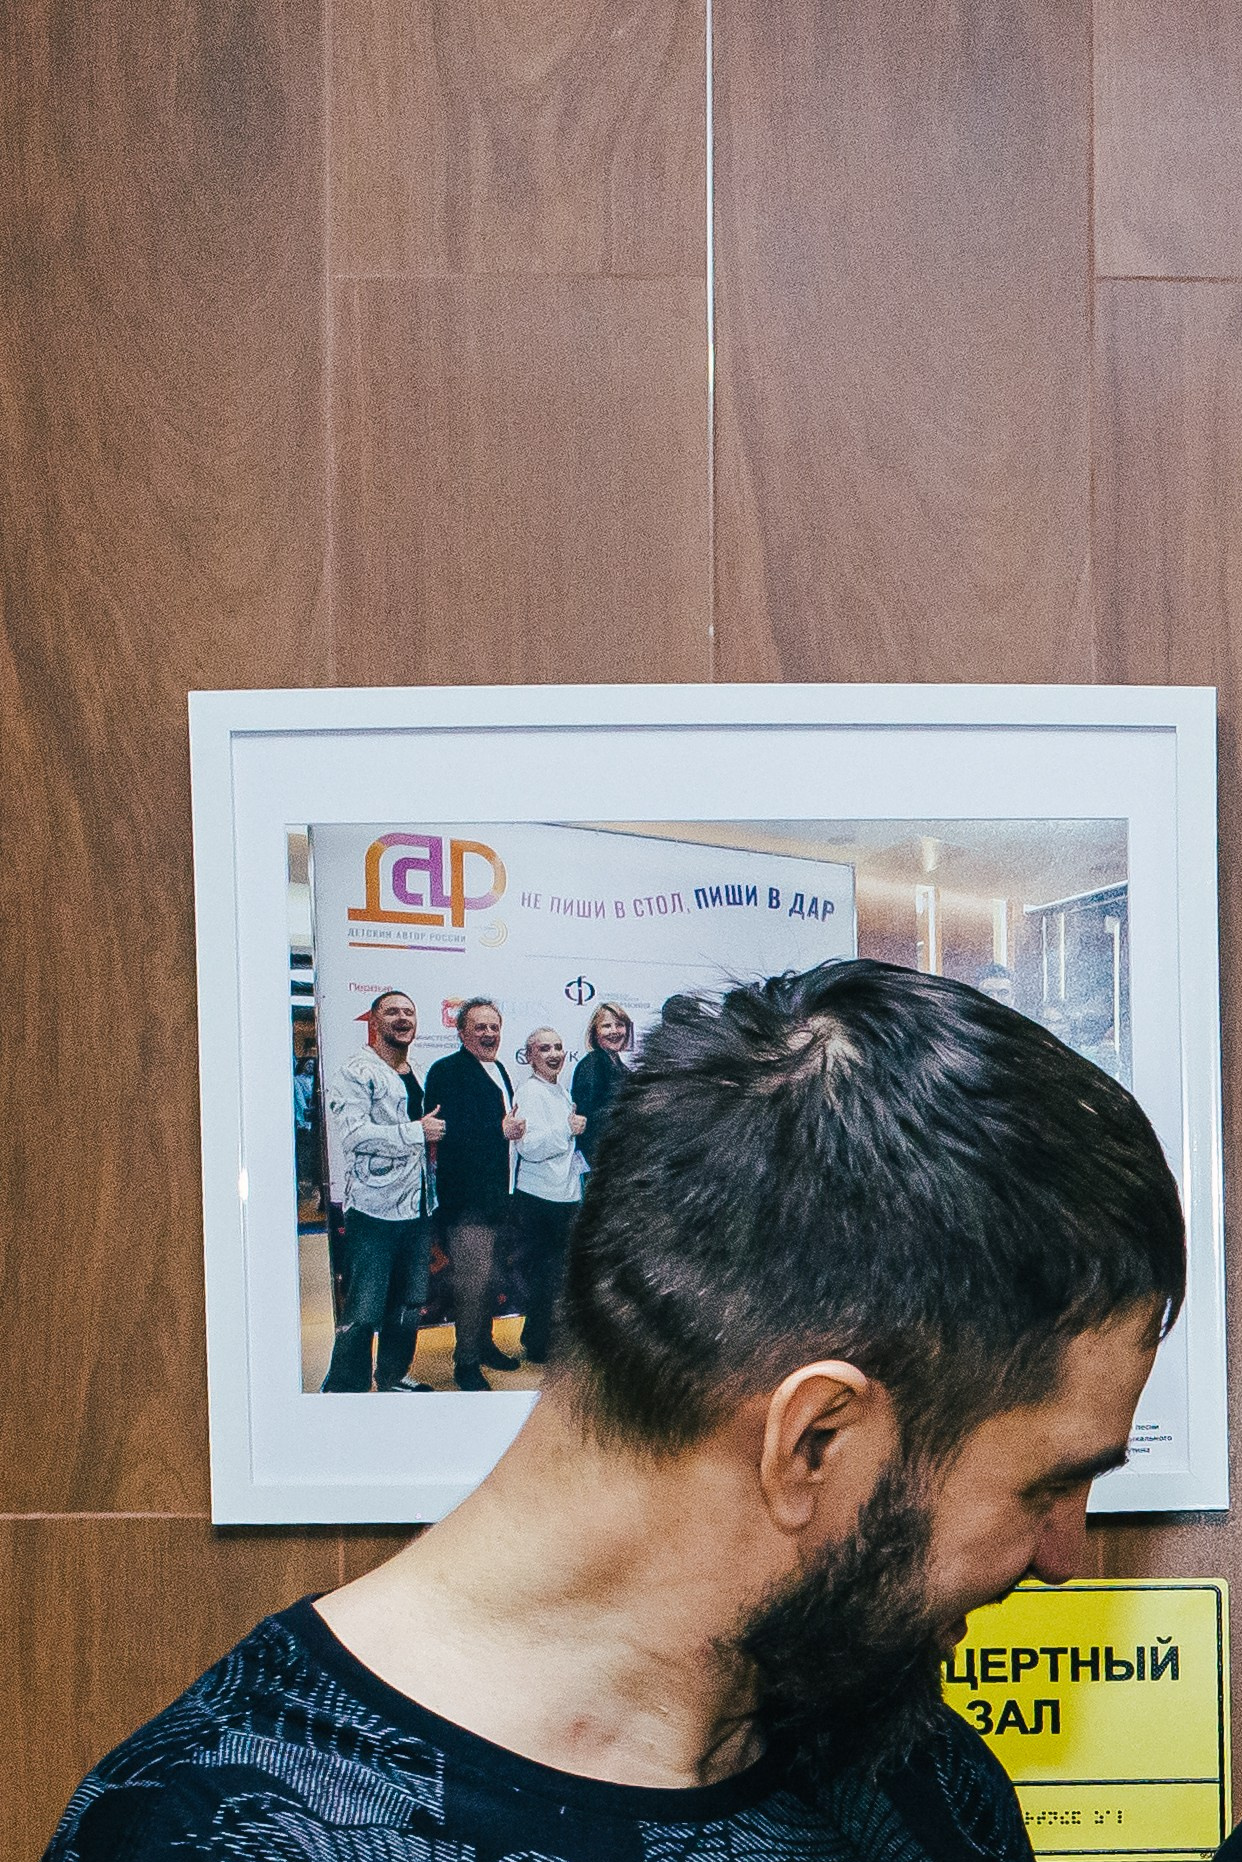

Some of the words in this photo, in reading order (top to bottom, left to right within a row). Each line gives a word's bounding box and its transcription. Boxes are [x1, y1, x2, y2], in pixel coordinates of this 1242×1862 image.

[520, 891, 542, 910] НЕ
[550, 895, 606, 919] ПИШИ
[614, 900, 626, 919] В
[632, 891, 690, 918] СТОЛ,
[694, 884, 759, 910] ПИШИ
[767, 886, 782, 910] В
[788, 892, 835, 922] ДАР
[945, 1635, 1180, 1690] ЦЕРТНЫЙ
[965, 1698, 1061, 1736] ЗАЛ
